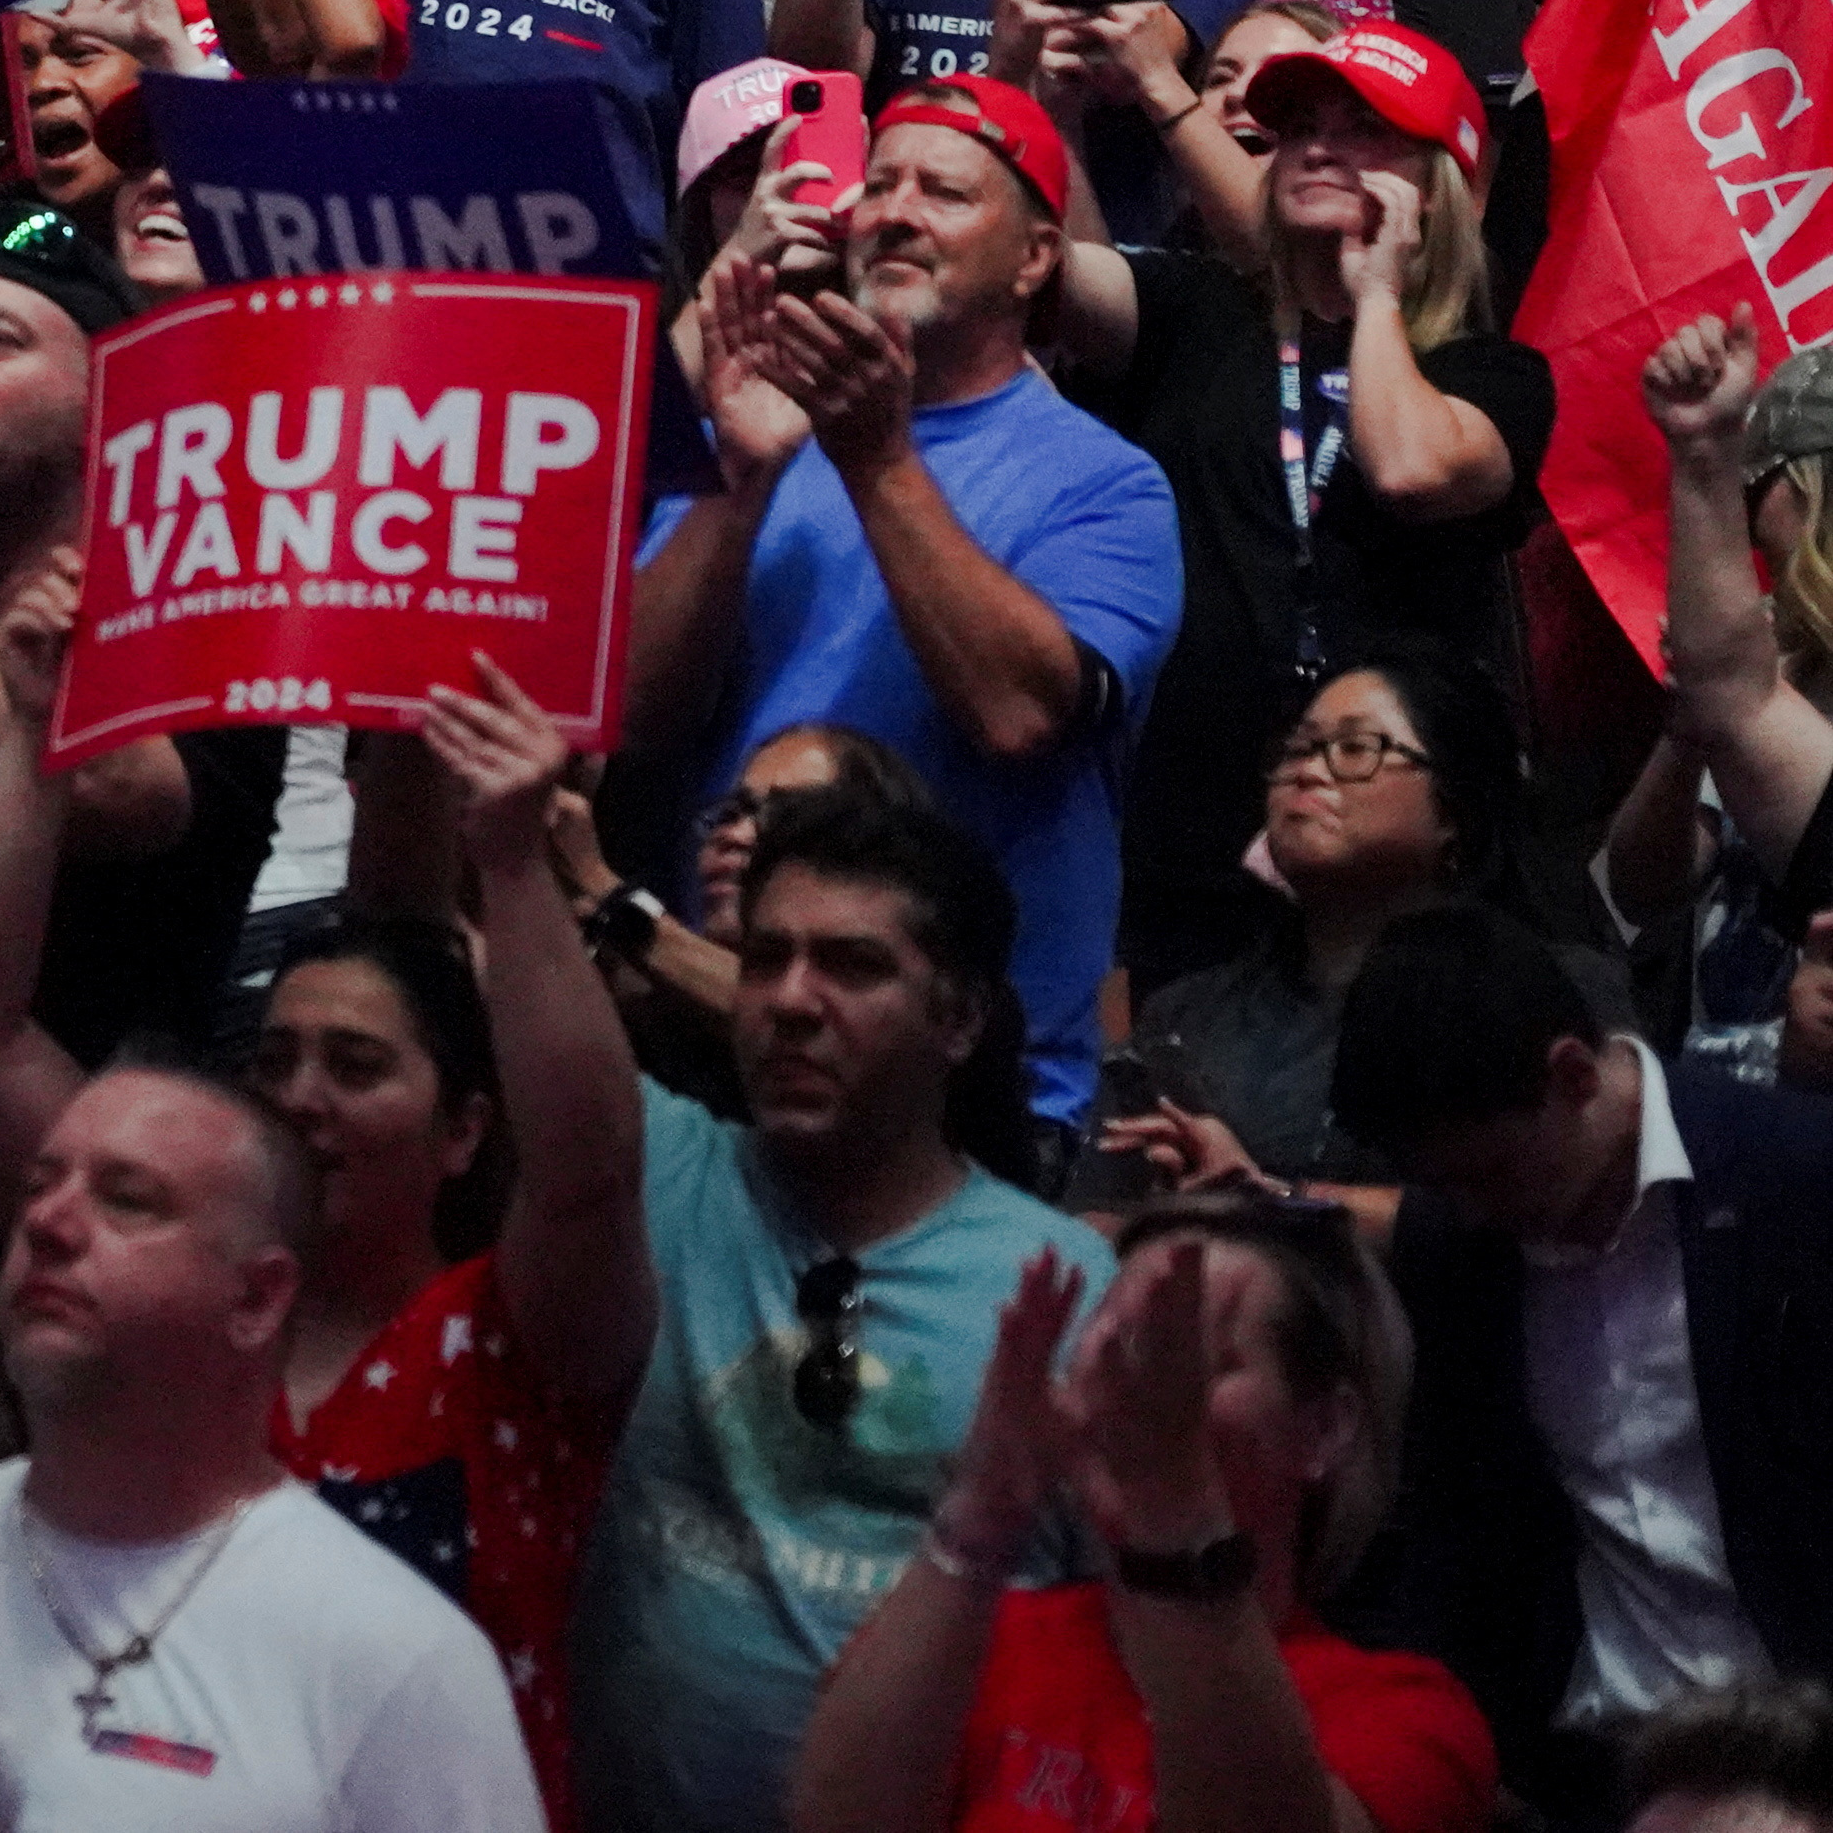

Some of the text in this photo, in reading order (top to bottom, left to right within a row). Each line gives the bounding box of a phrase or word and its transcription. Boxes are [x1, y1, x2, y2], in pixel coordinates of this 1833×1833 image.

[899, 47, 992, 79] 202
[1352, 31, 1429, 75] AMERICA
[194, 185, 601, 276] TRUMP
[102, 384, 602, 530] TRUMP
[123, 490, 525, 601] VANCE
[161, 579, 291, 625] AMERICA
[298, 579, 414, 611] GREAT
[422, 584, 550, 623] AGAIN!
[224, 677, 334, 713] 2024
